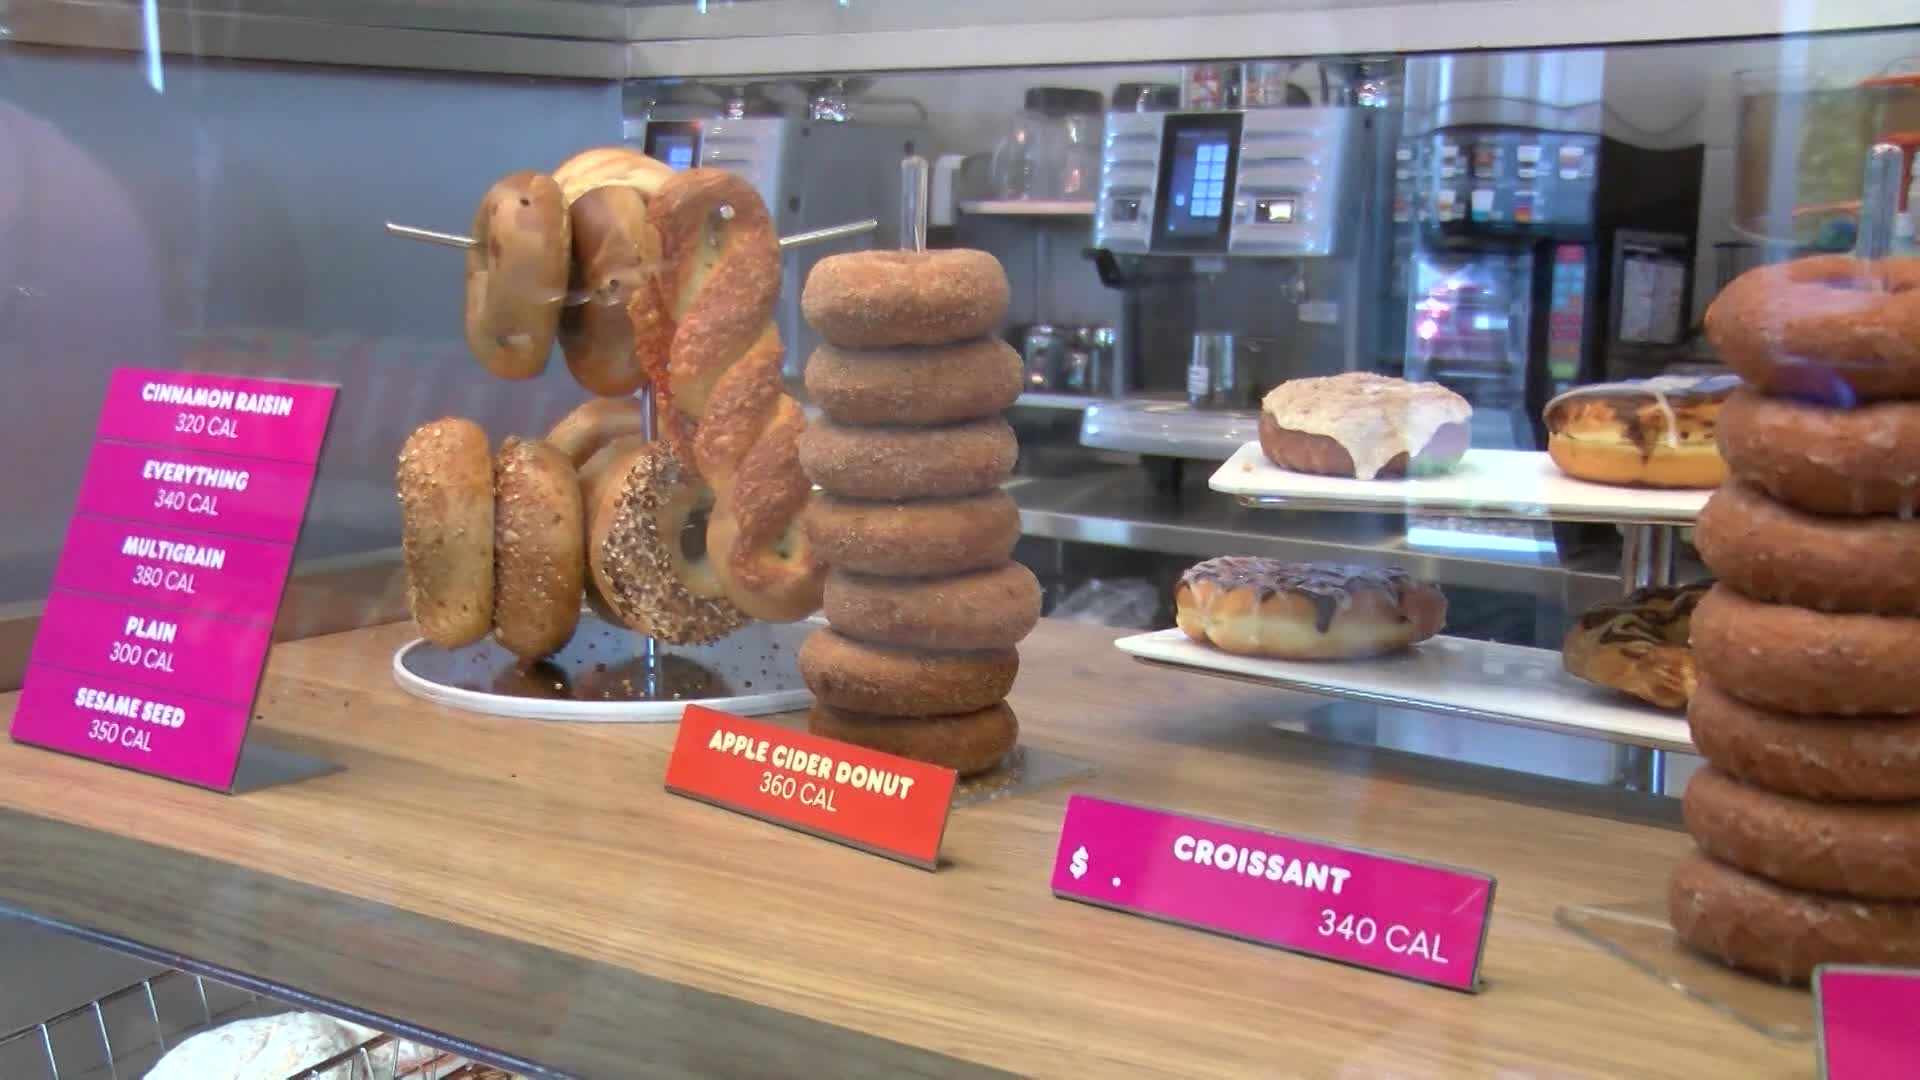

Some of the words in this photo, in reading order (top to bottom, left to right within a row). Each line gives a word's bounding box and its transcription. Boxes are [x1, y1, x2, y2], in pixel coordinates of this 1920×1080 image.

[142, 382, 234, 410] CINNAMON
[234, 391, 294, 416] RAISIN
[175, 413, 204, 434] 320
[207, 417, 239, 438] CAL
[143, 460, 249, 490] EVERYTHING
[154, 489, 184, 510] 340
[187, 493, 219, 516] CAL
[121, 536, 225, 570] MULTIGRAIN
[132, 565, 162, 588] 380
[165, 570, 196, 594] CAL
[124, 616, 177, 643] PLAIN
[109, 642, 141, 665] 300
[144, 647, 175, 672] CAL
[75, 687, 140, 718] SESAME
[141, 700, 185, 728] SEED
[88, 720, 119, 743] 350
[121, 726, 153, 752] CAL
[708, 729, 769, 762] APPLE
[772, 745, 832, 780] CIDER
[835, 761, 914, 800] DONUT
[759, 771, 796, 800] 360
[800, 783, 837, 812] CAL
[1173, 835, 1352, 895] CROISSANT
[1317, 908, 1377, 945] 340
[1385, 924, 1449, 964] CAL
